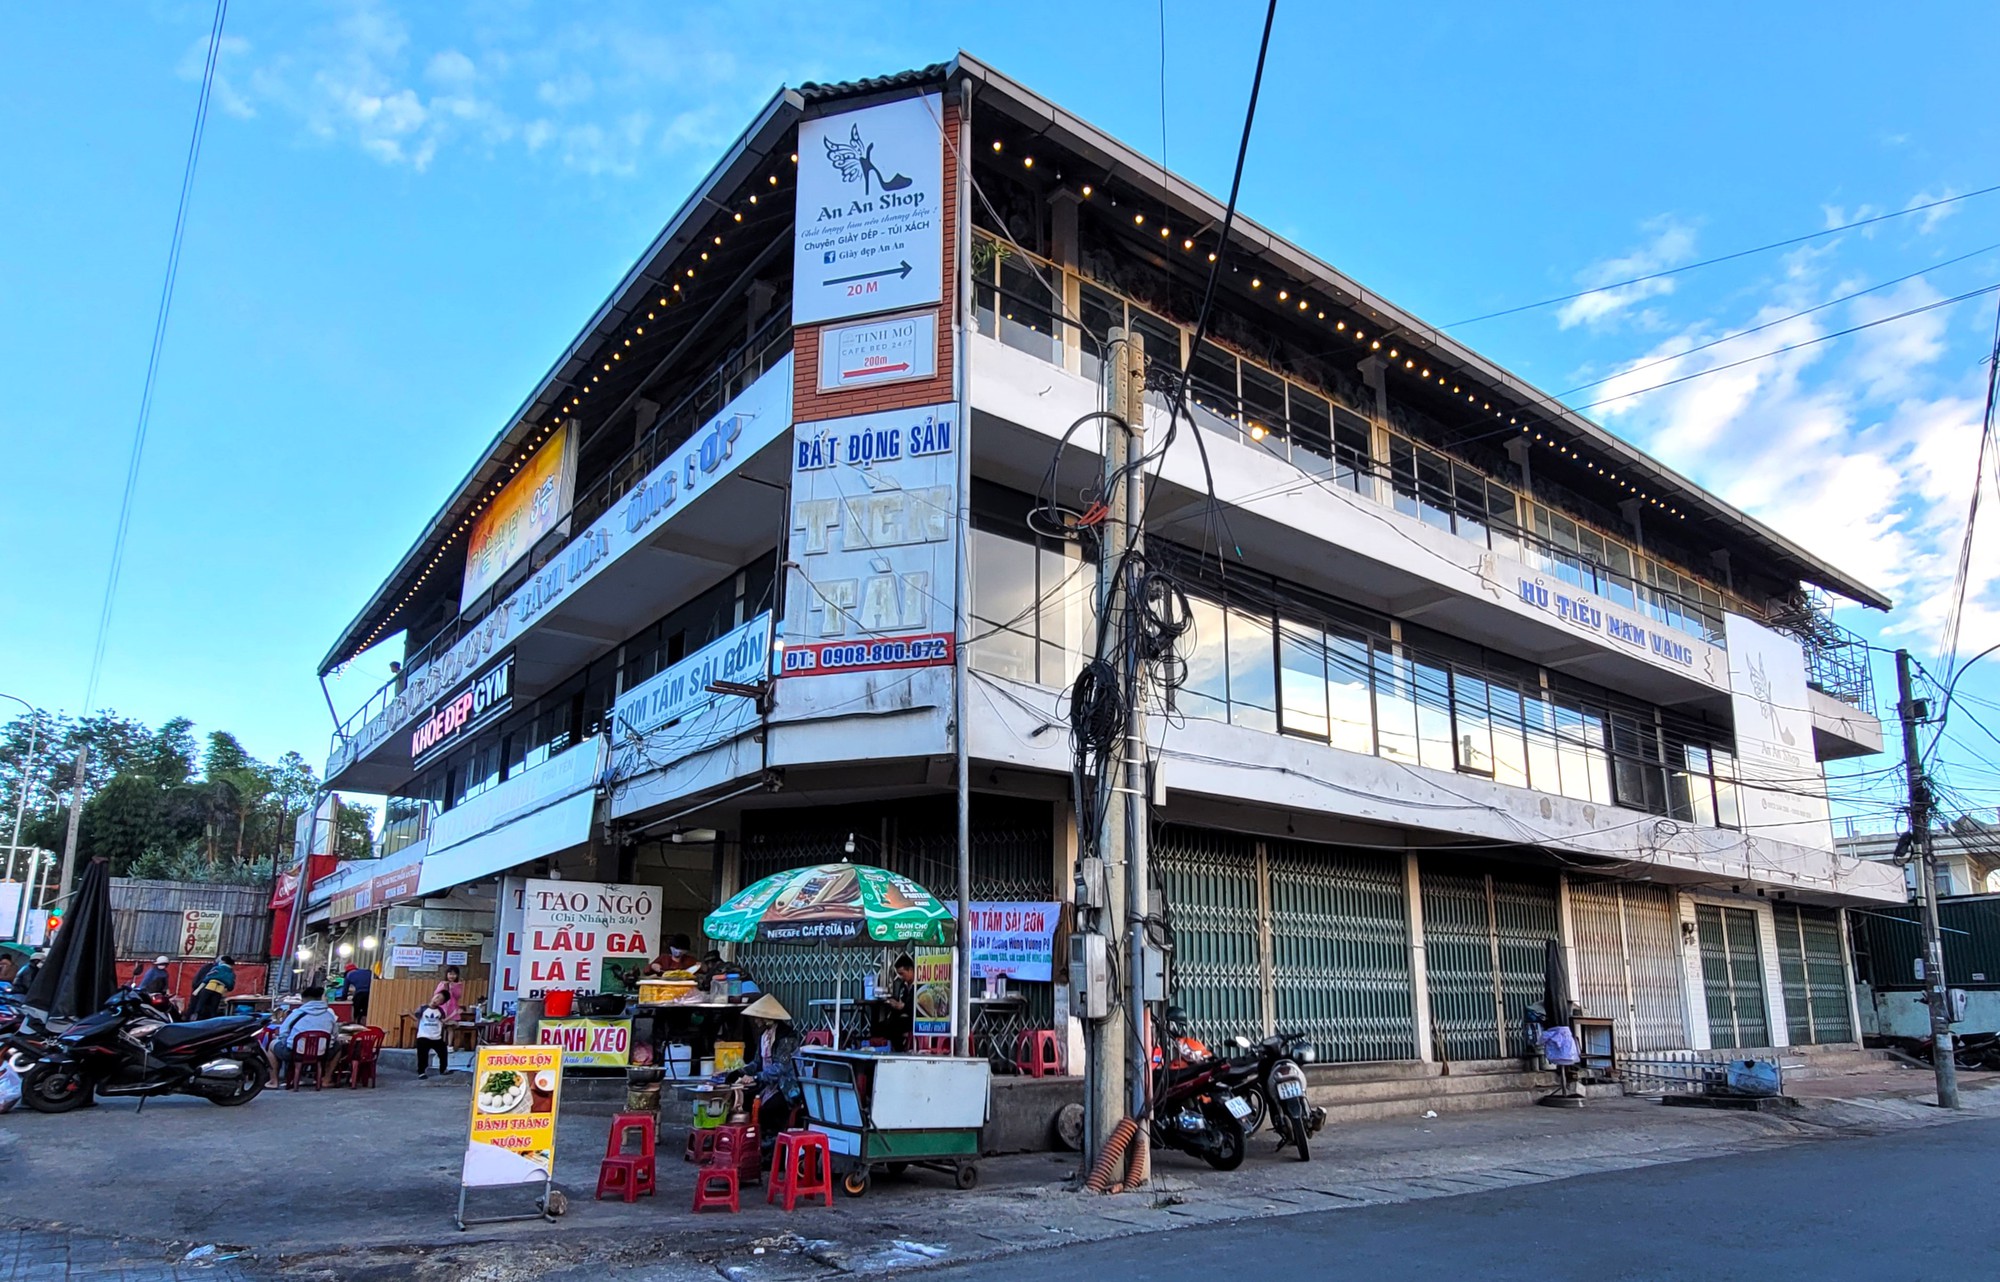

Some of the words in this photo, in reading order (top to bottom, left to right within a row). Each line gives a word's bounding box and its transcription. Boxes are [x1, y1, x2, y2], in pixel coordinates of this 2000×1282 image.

[817, 207, 842, 222] An
[847, 201, 872, 216] An
[880, 192, 924, 210] Shop
[804, 239, 835, 250] Chuyên
[838, 233, 859, 244] GIÀY
[861, 229, 878, 240] DÉP
[888, 224, 902, 235] TÚI
[905, 220, 930, 232] XÁCH
[839, 250, 858, 260] Giày
[860, 247, 876, 257] đẹp
[878, 244, 890, 252] An
[892, 242, 904, 250] An
[847, 285, 862, 296] 20
[866, 281, 878, 294] M
[856, 330, 887, 344] TINH
[893, 325, 912, 338] MƠ
[870, 344, 887, 352] BED
[892, 340, 912, 349] 24/7
[864, 356, 888, 367] 200m
[798, 430, 838, 468] BẤT
[848, 428, 900, 466] ĐỘNG
[910, 416, 950, 454] SẢN
[1520, 577, 1548, 608] HỦ
[1556, 596, 1600, 629] TIẾU
[1608, 615, 1646, 647] NAM
[1651, 632, 1692, 666] VANG
[786, 650, 816, 670] ĐT:
[822, 638, 946, 668] 0908.800.072
[616, 695, 647, 734] CƠM
[652, 672, 684, 716] TẤM
[689, 656, 718, 696] SÀI
[411, 705, 444, 758] KHỎE
[444, 692, 472, 736] ĐẸP
[473, 664, 508, 714] GYM
[537, 892, 588, 912] TAO
[596, 892, 652, 920] NGỘ
[551, 912, 574, 922] (Chi
[578, 914, 616, 925] Nhánh
[619, 916, 638, 926] 3/4)
[982, 904, 1002, 932] TẤM
[1006, 908, 1021, 932] SÀI
[1024, 907, 1044, 932] GÒN
[533, 924, 595, 952] LẨU
[607, 930, 647, 953] GÀ
[826, 922, 843, 936] SỮA
[531, 958, 565, 982] LÁ
[576, 958, 592, 982] É
[541, 1024, 587, 1052] BÁNH
[590, 1024, 627, 1052] XÈO
[487, 1054, 526, 1066] TRỨNG
[530, 1053, 552, 1068] LỘN
[476, 1118, 508, 1131] BÁNH
[511, 1117, 550, 1129] TRÁNG
[491, 1134, 532, 1148] NƯỚNG
